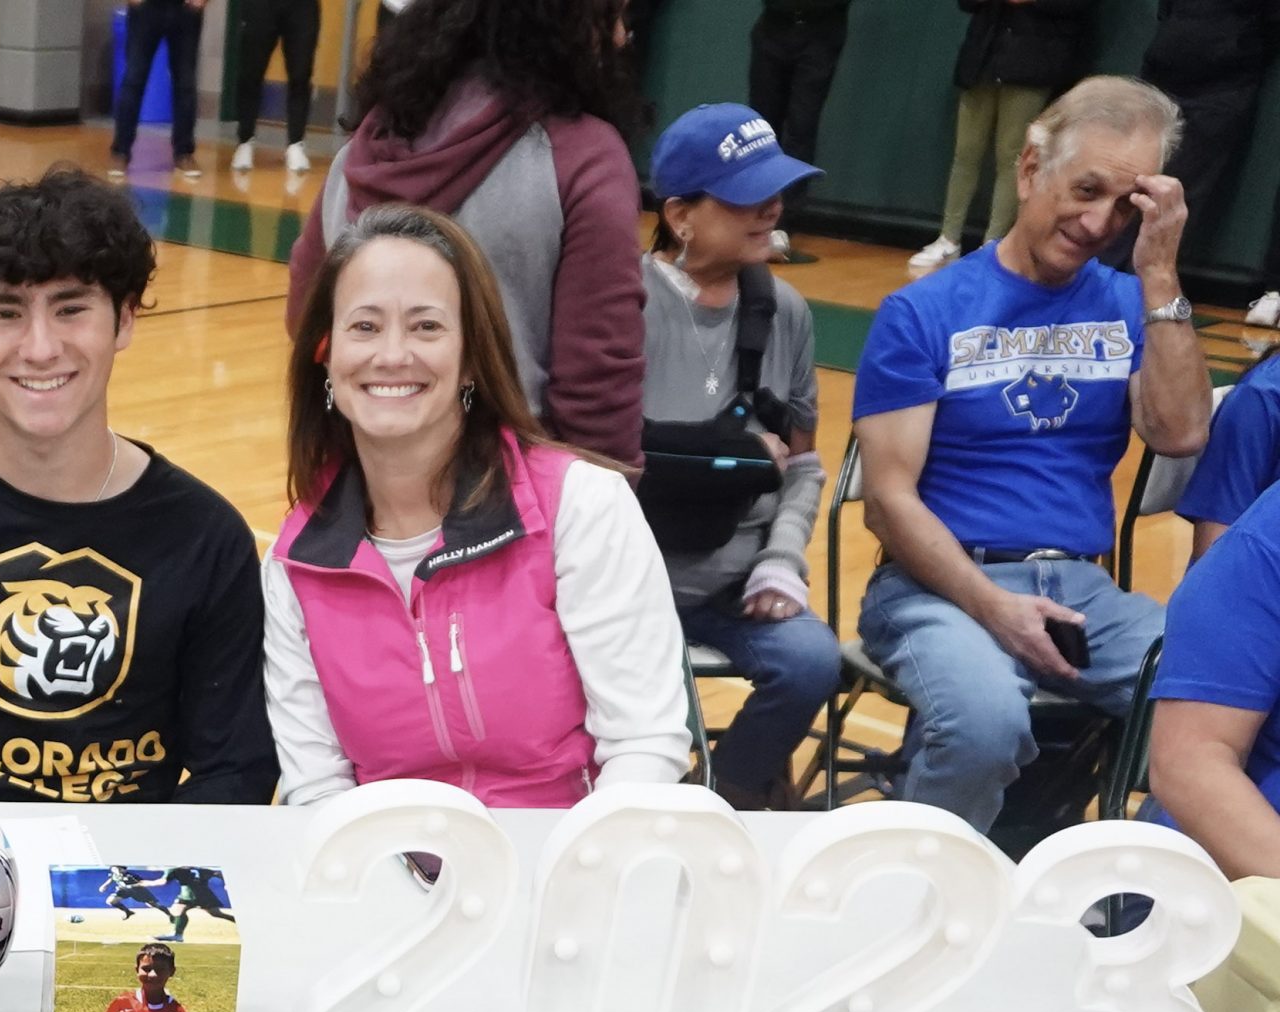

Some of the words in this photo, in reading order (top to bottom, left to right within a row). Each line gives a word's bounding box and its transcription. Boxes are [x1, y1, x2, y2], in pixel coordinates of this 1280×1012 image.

[719, 132, 743, 158] ST.
[998, 324, 1135, 358] MARY'S
[969, 363, 1113, 381] UNIVERSITY
[428, 548, 464, 568] HELLY
[466, 529, 515, 555] HANSEN
